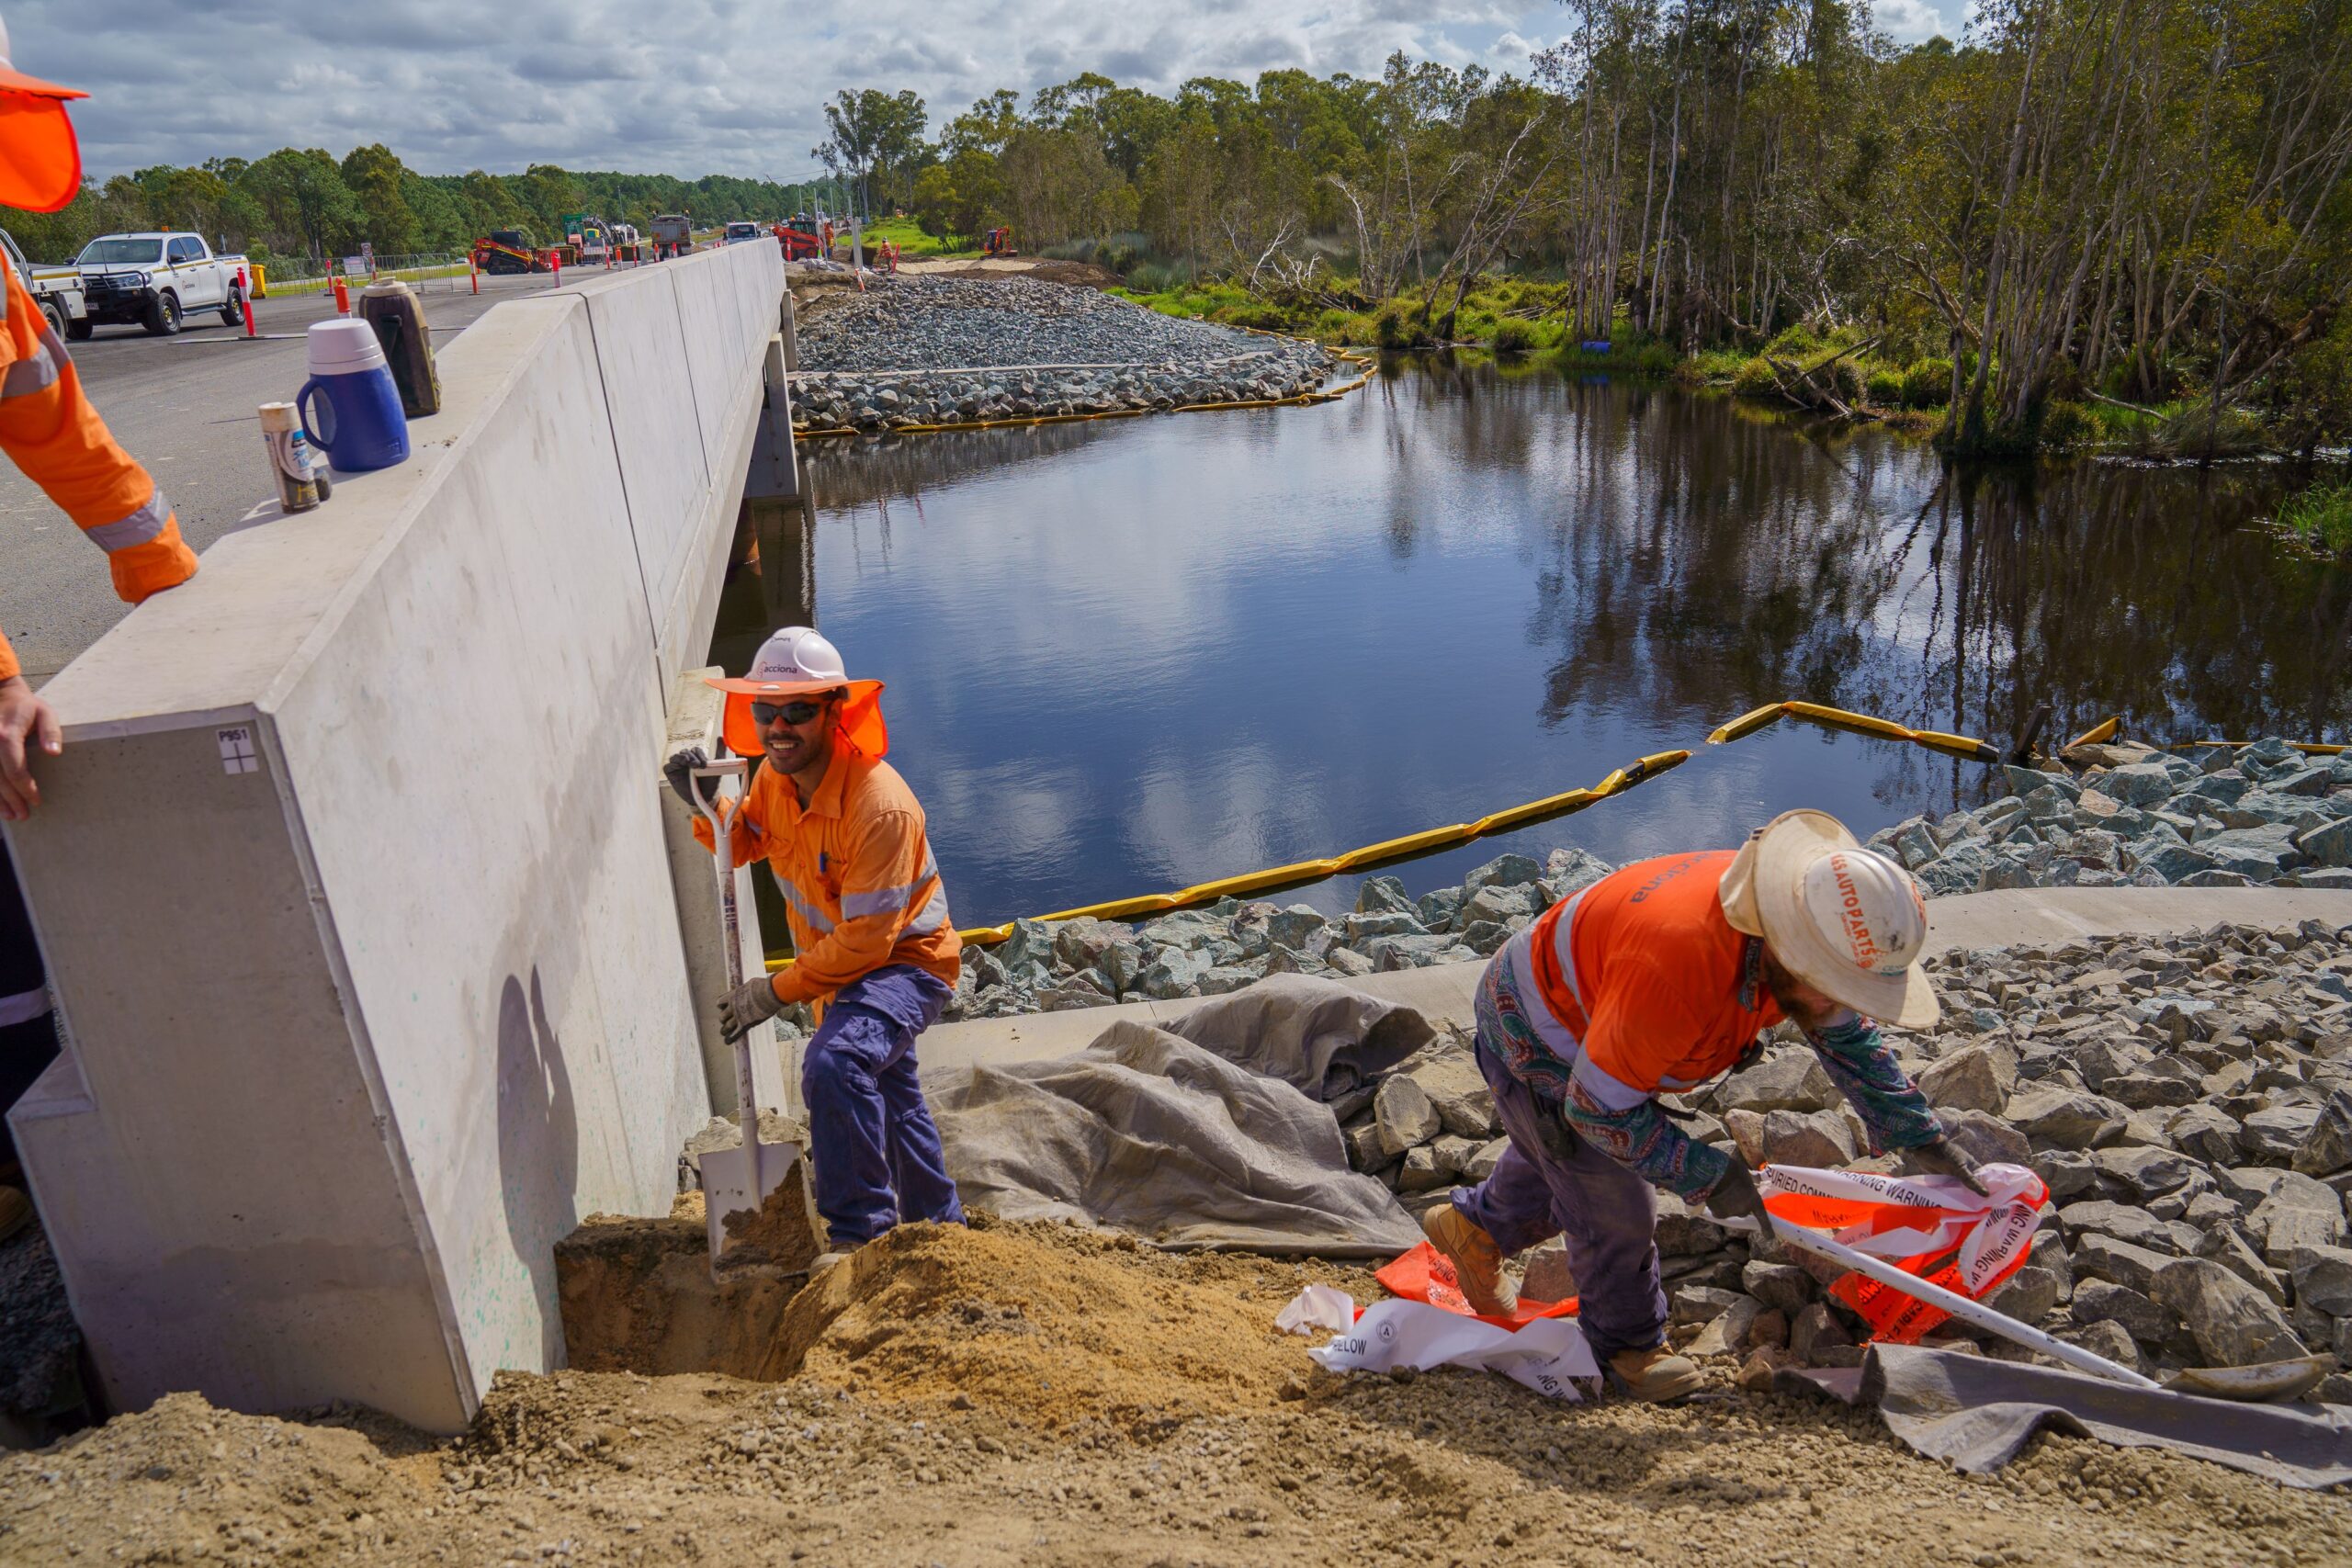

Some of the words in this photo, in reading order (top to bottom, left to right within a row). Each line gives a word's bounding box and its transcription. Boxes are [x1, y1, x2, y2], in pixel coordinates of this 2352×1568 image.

[763, 664, 797, 674] acciona
[1835, 873, 1860, 908] AUTO
[1847, 908, 1877, 956] PARTS
